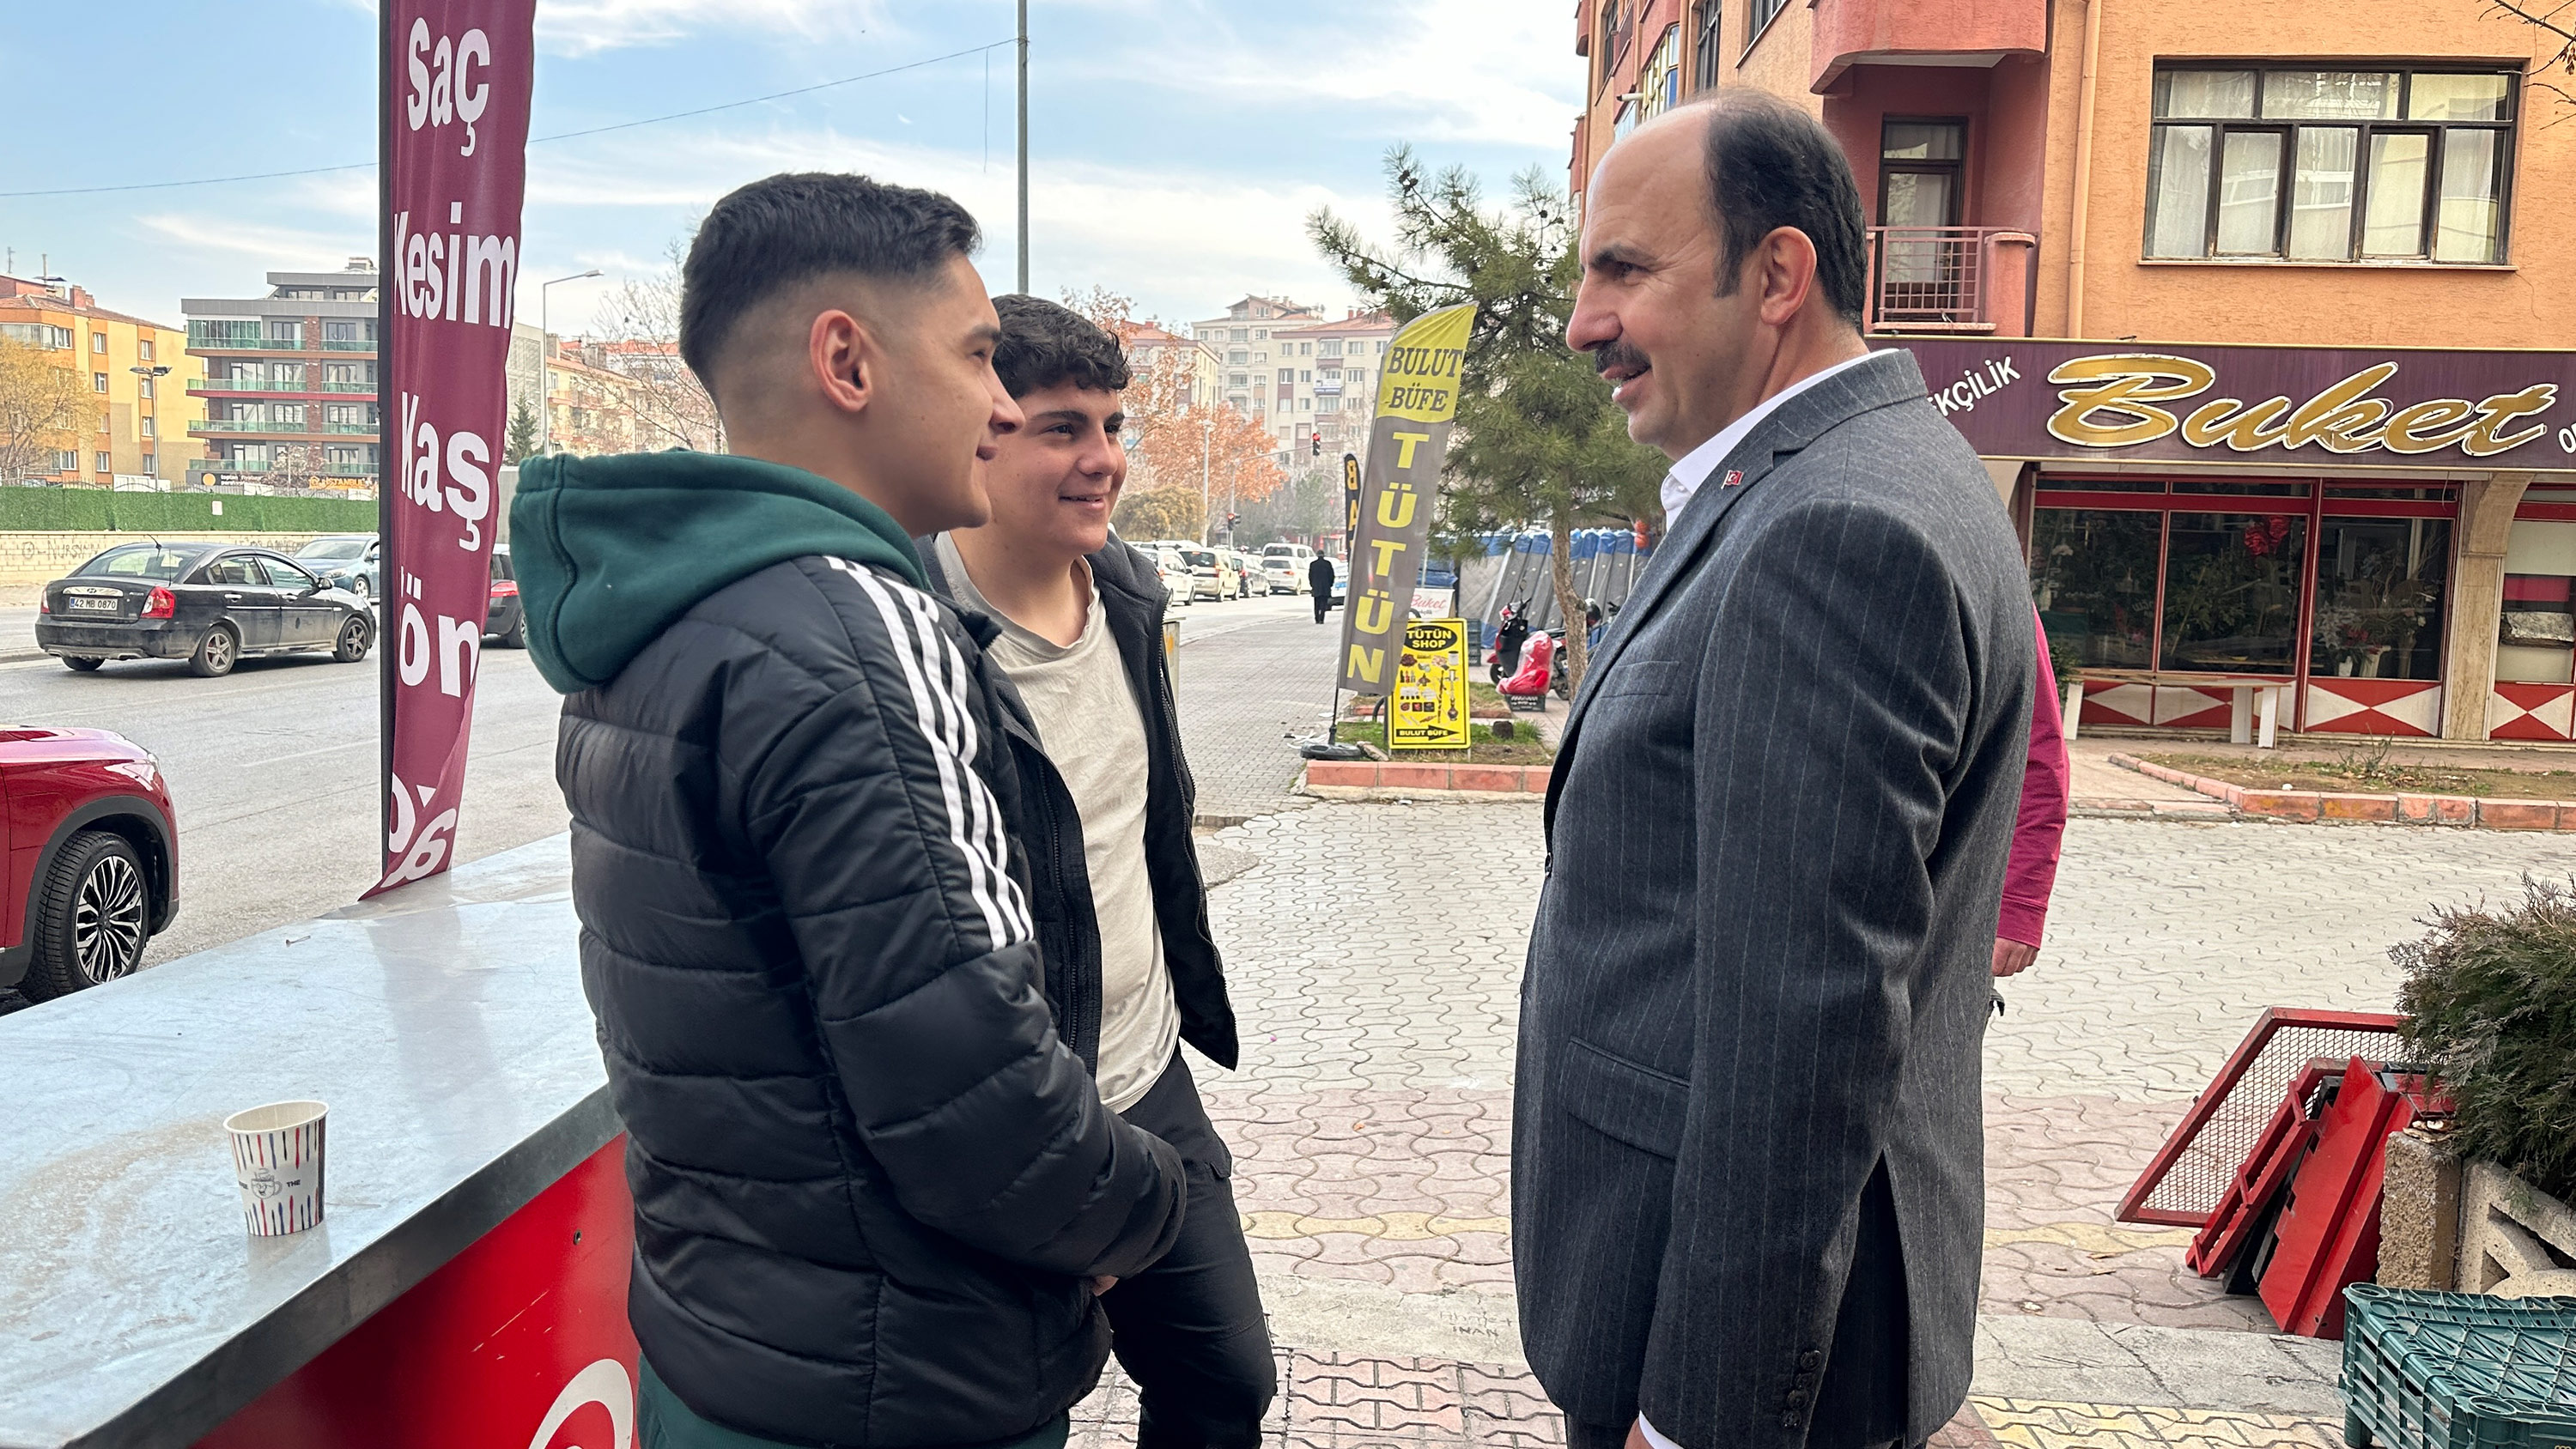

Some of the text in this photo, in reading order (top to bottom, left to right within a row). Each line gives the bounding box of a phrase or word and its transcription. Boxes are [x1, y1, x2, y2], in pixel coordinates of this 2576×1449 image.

[407, 17, 490, 157] Saç
[394, 202, 515, 330] Kesim
[1387, 347, 1463, 378] BULUT
[1388, 382, 1449, 412] BÜFE
[1927, 356, 2021, 417] KÇİLİK
[2047, 353, 2559, 457] Buket
[2559, 422, 2576, 454] O
[401, 391, 490, 552] Kaş
[1347, 432, 1431, 684] TÜTÜN
[75, 599, 116, 609] 42 MB 0870
[1406, 628, 1452, 640] TÜTÜN
[1412, 640, 1446, 648] SHOP
[287, 1179, 301, 1188] THE
